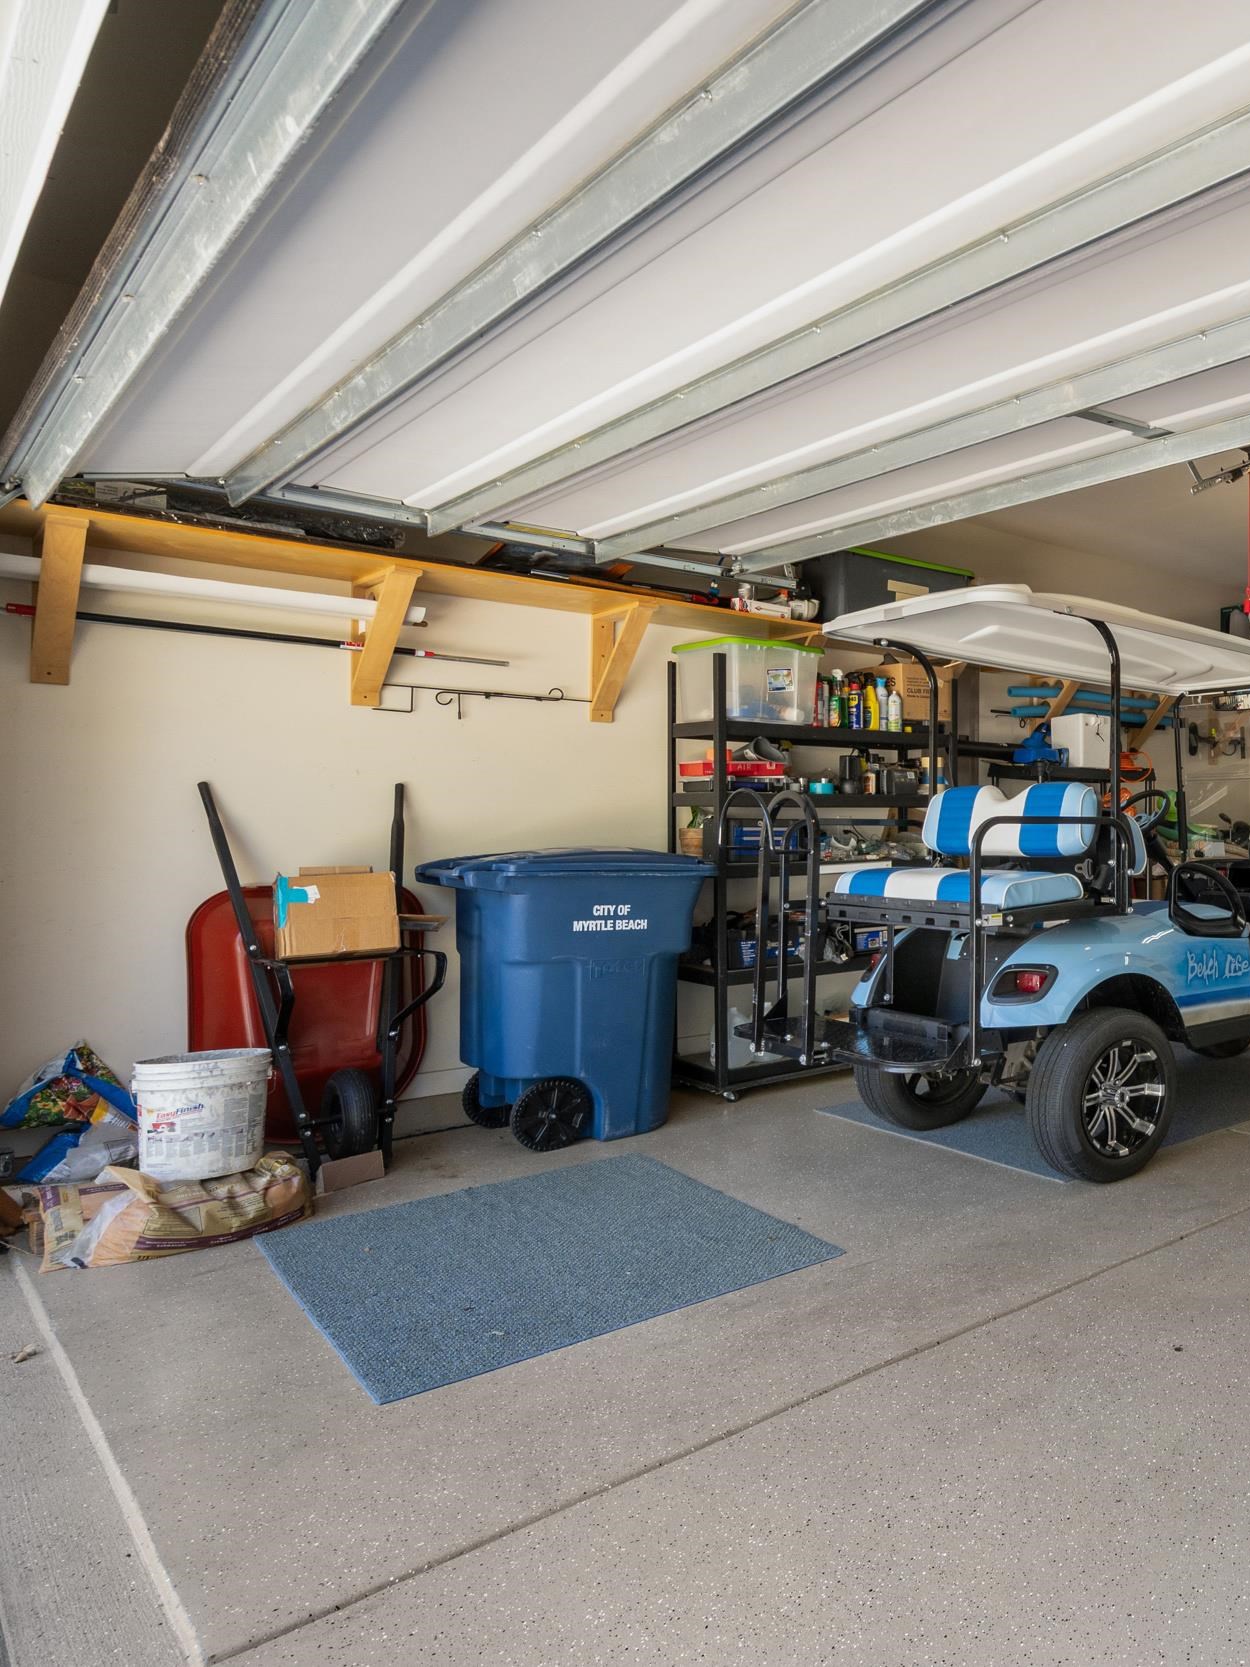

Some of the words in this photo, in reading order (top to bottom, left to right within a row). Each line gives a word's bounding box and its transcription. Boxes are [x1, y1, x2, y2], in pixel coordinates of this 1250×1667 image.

[592, 904, 617, 916] CITY
[617, 904, 632, 916] OF
[572, 919, 615, 932] MYRTLE
[615, 918, 648, 931] BEACH
[1223, 953, 1250, 979] Life
